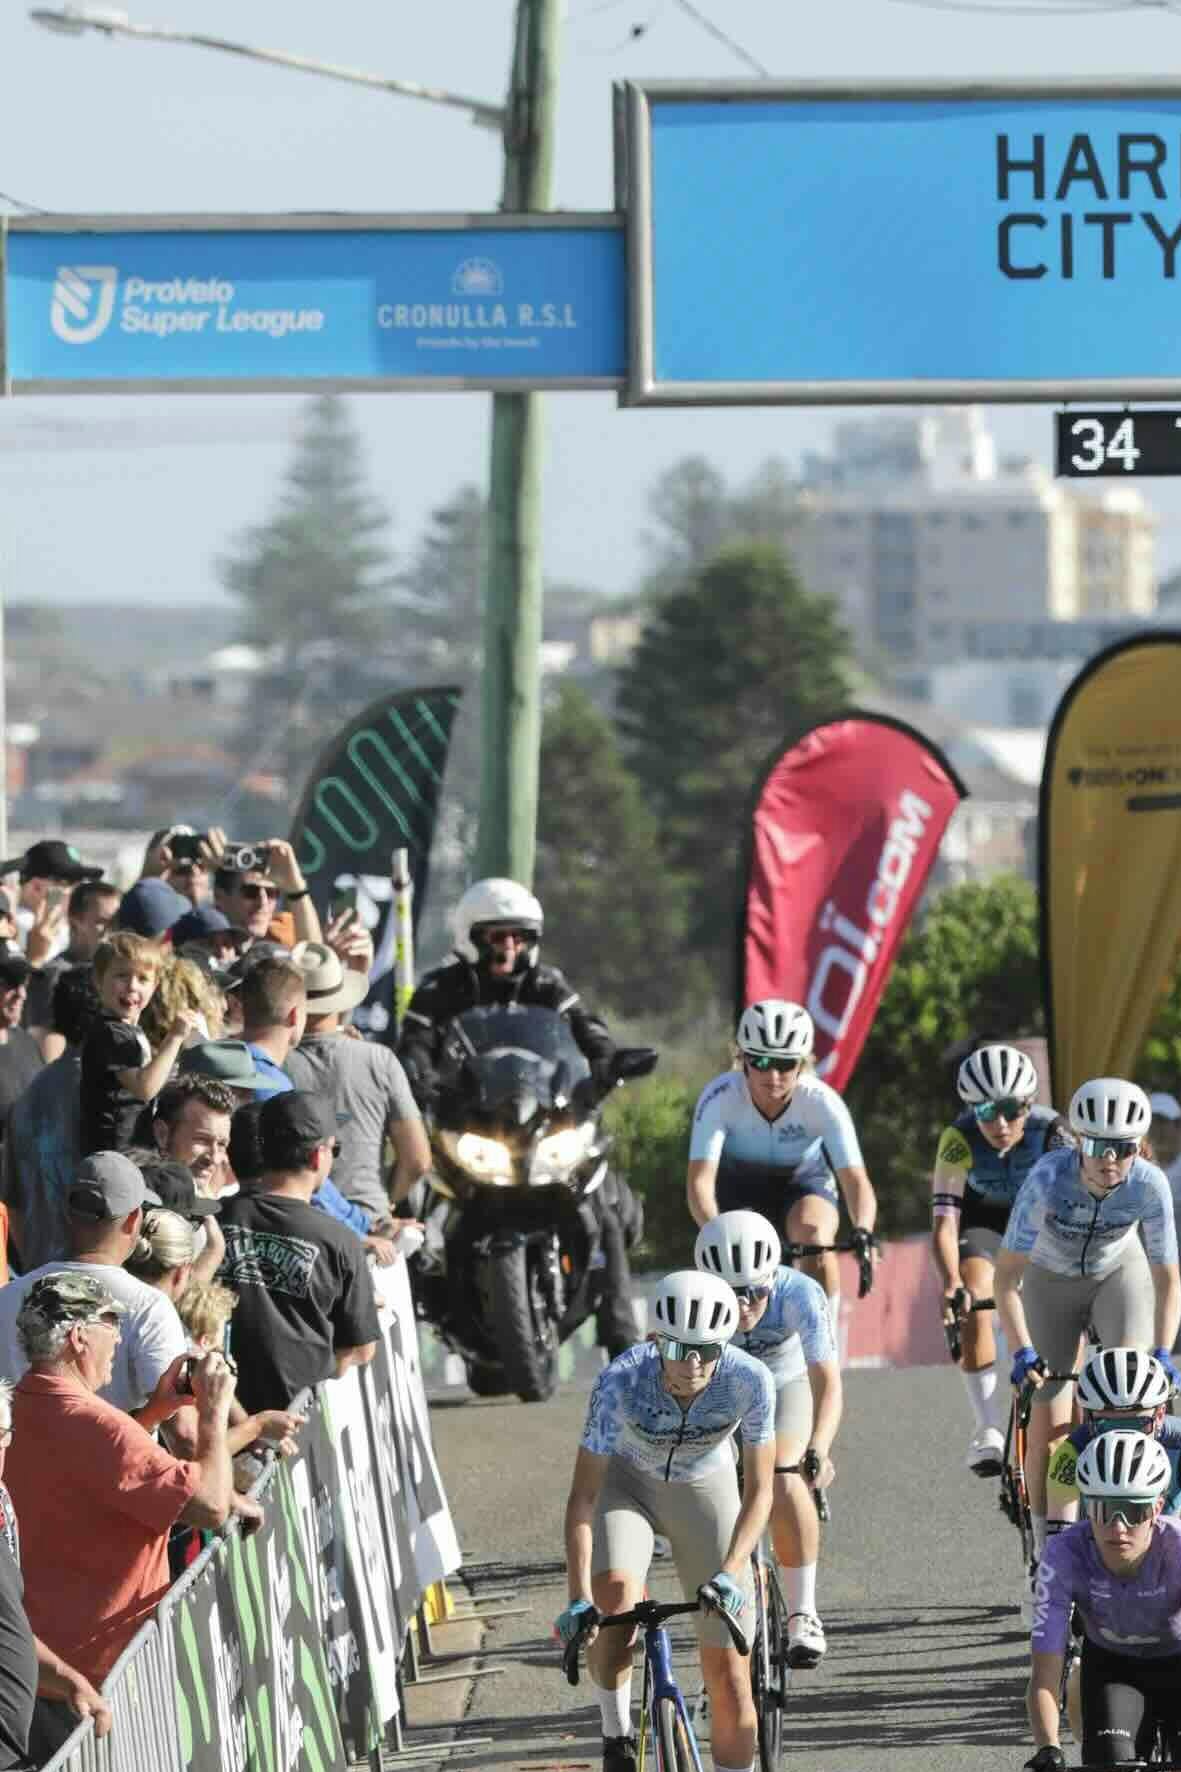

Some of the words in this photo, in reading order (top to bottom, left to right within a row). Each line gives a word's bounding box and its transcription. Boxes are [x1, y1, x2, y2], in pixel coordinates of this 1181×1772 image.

[124, 277, 235, 303] ProVelo
[120, 304, 210, 337] Super
[216, 303, 325, 338] League
[377, 304, 507, 328] CRONULLA
[1070, 418, 1141, 471] 34
